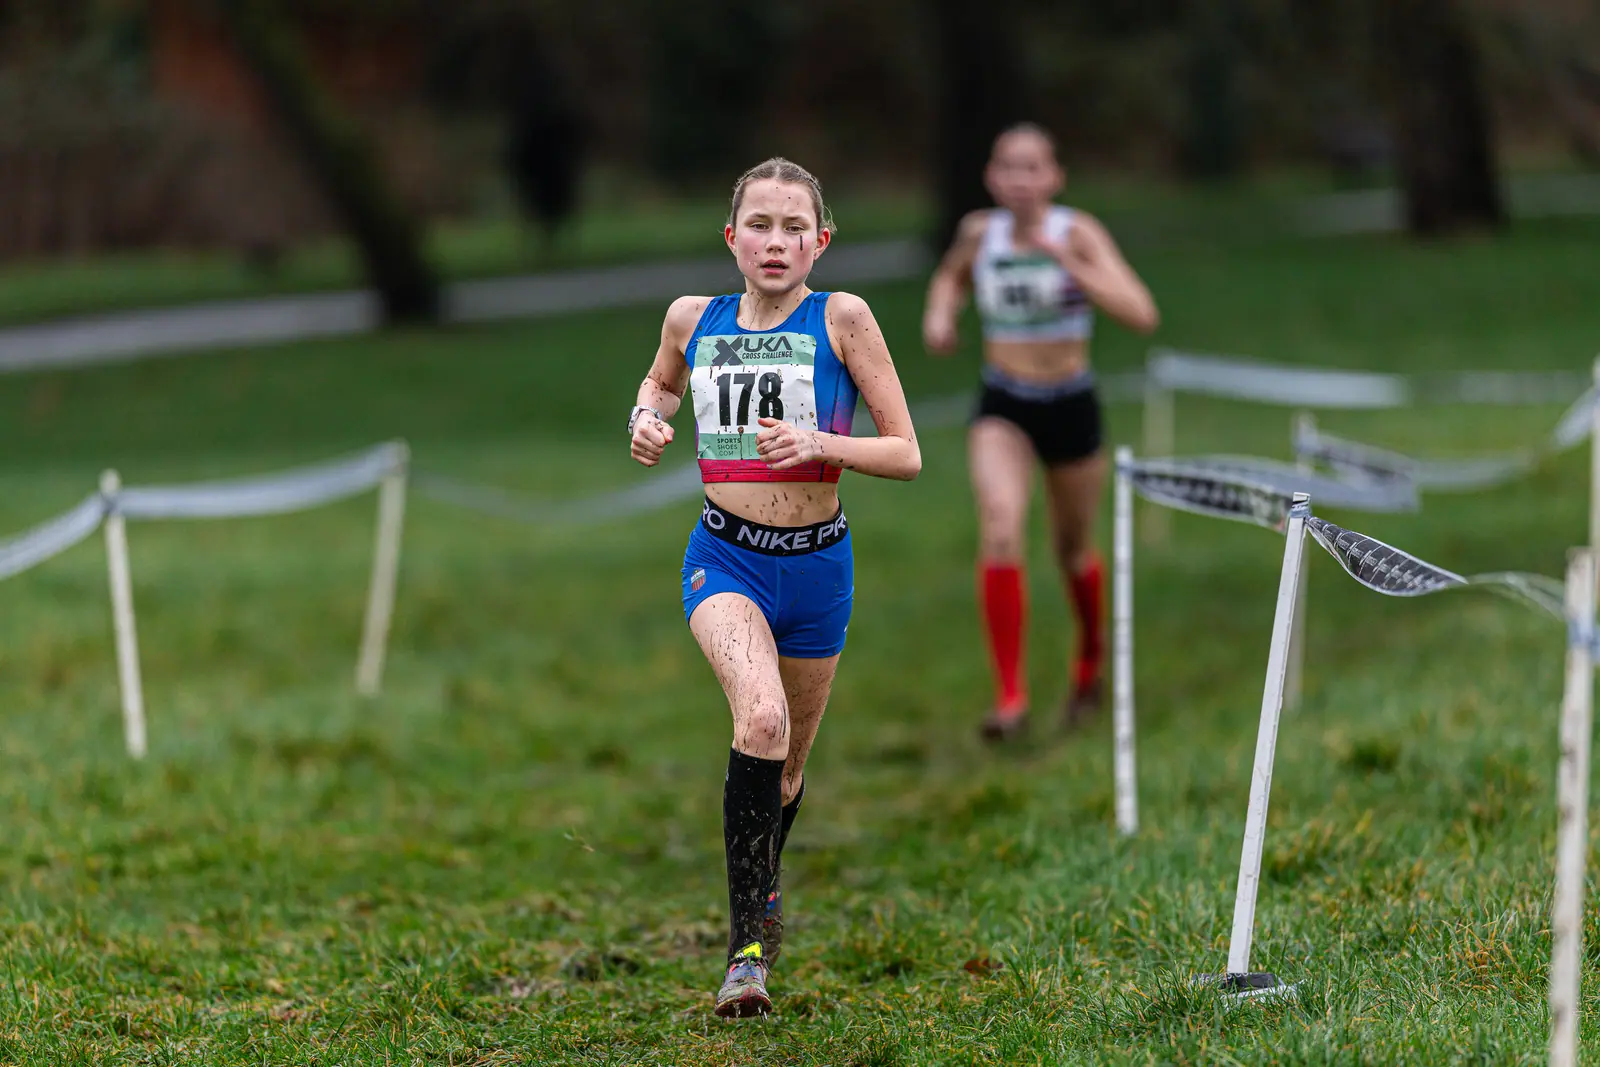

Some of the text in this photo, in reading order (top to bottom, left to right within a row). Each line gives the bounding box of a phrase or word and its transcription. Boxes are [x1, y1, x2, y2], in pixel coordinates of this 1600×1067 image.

[742, 350, 793, 360] CROSS CHALLENGE
[716, 371, 784, 427] 178
[736, 524, 813, 551] NIKE
[817, 510, 847, 545] PR
